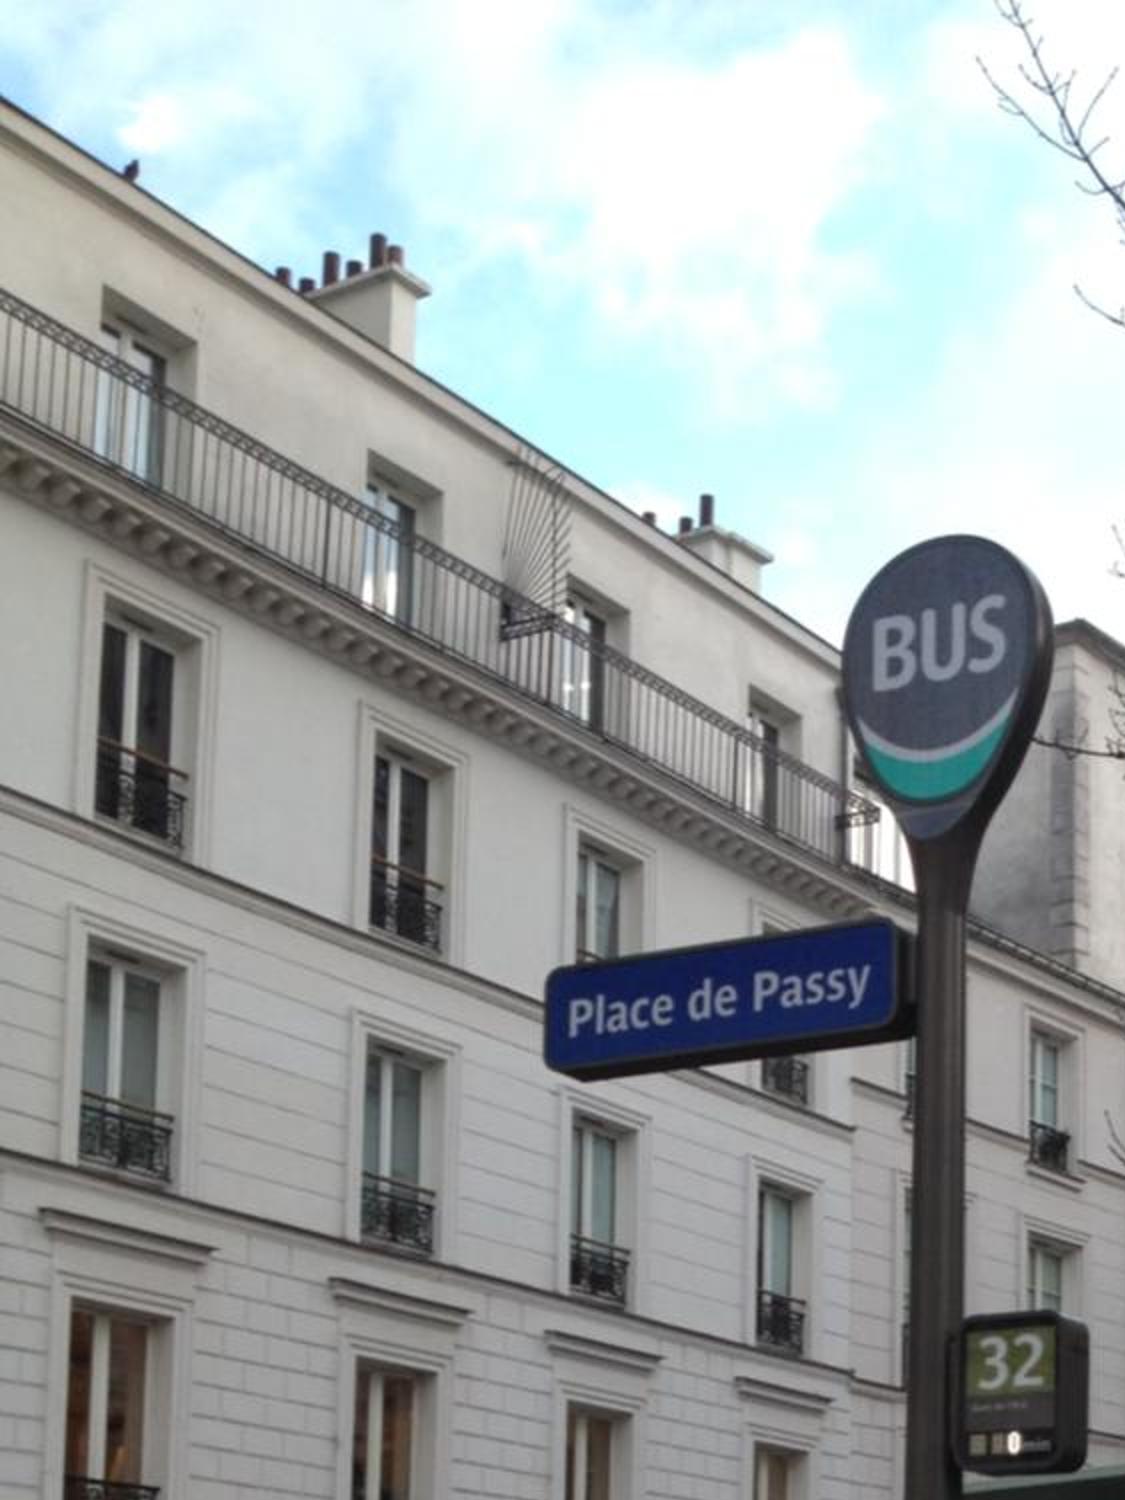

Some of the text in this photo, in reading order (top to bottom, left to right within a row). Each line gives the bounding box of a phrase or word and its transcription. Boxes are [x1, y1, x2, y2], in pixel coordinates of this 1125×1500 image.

[872, 593, 1008, 692] BUS
[567, 965, 872, 1039] Place de Passy
[978, 1332, 1044, 1391] 32
